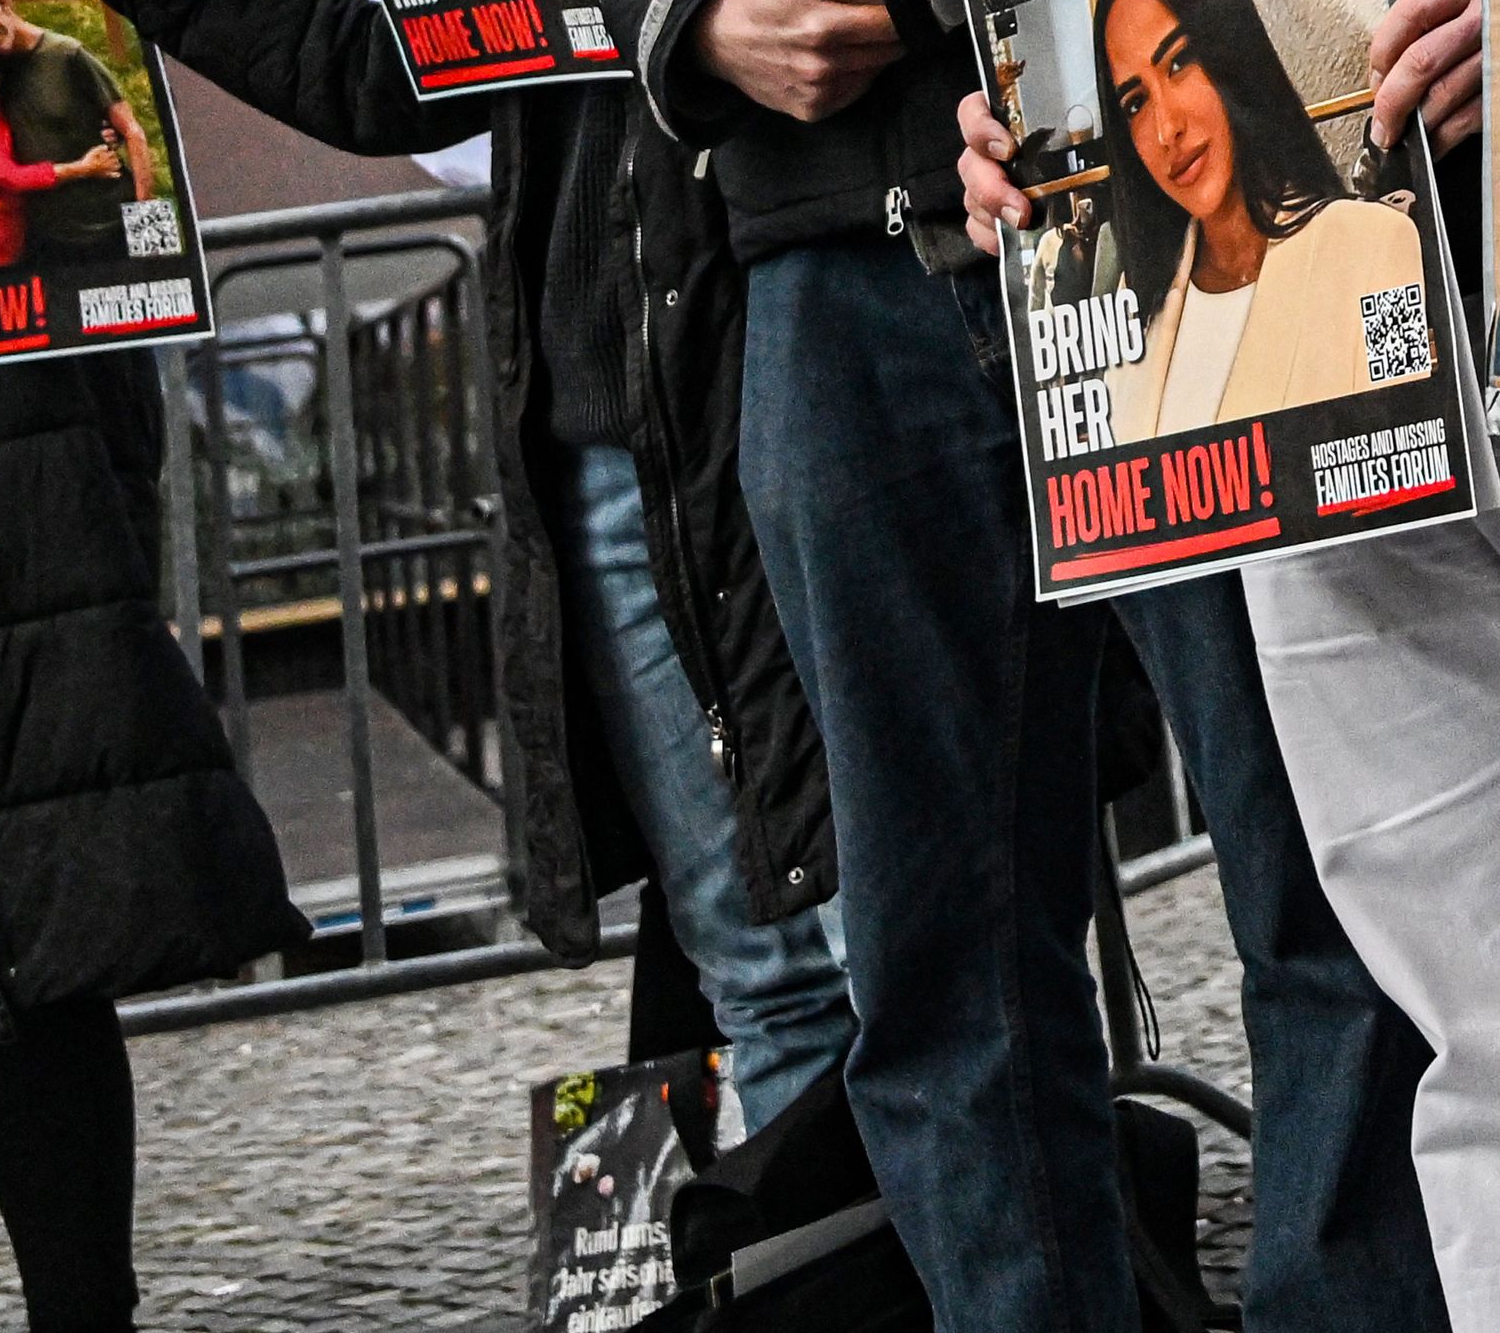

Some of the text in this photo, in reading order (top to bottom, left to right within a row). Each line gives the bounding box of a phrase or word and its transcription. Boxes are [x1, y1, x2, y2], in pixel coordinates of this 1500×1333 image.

[402, 8, 480, 66] HOME
[1029, 288, 1143, 381] BRING
[1037, 377, 1115, 462] HER
[1311, 417, 1446, 469] HOSTAGES AND MISSING
[1047, 421, 1273, 547] HOME NOW!
[1315, 444, 1450, 506] FAMILIES FORUM
